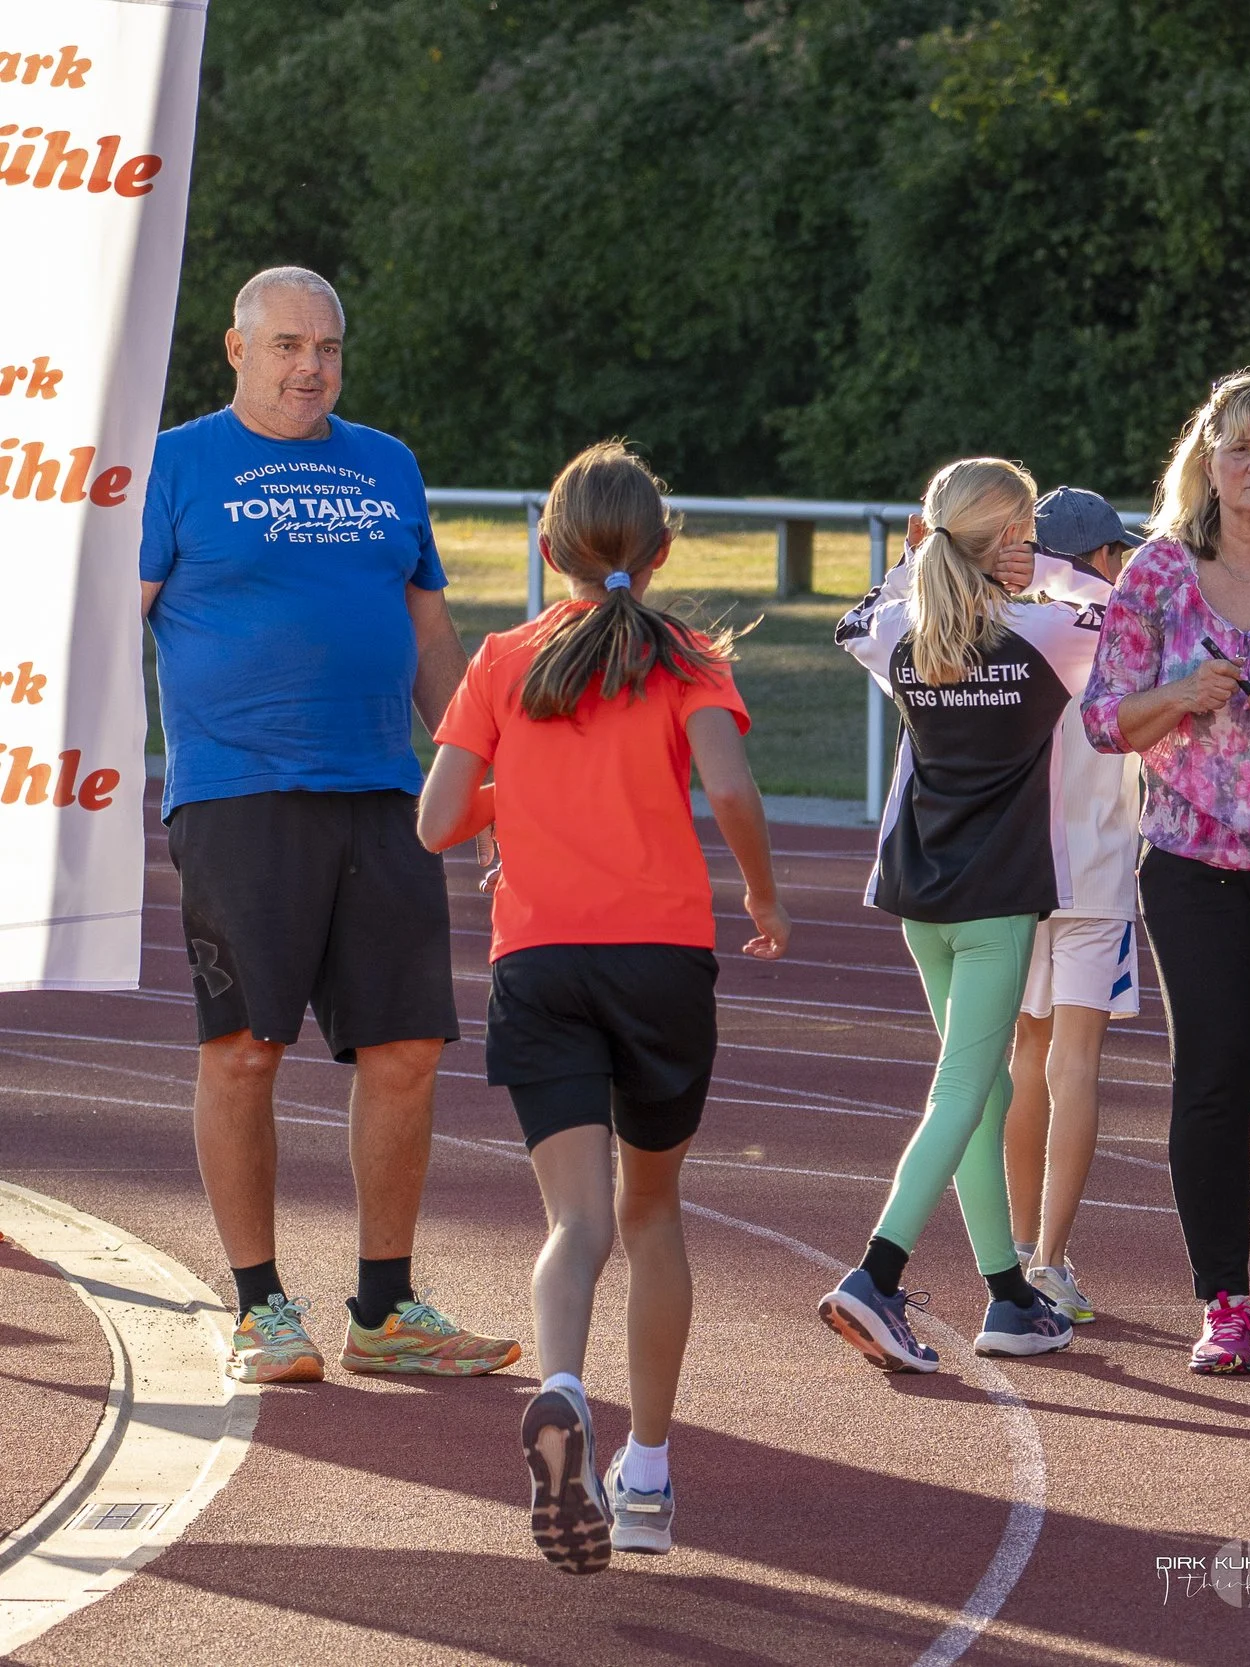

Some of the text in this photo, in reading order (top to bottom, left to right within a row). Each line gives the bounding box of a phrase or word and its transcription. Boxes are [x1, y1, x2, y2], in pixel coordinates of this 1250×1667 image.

[234, 462, 377, 487] ROUGH URBAN STYLE
[260, 484, 363, 496] TRDMK 957/872
[223, 498, 400, 523] TOM TAILOR
[263, 530, 386, 543] 19 EST SINCE 62
[906, 689, 1022, 707] TSG Wehrheim
[0, 743, 120, 812] hle
